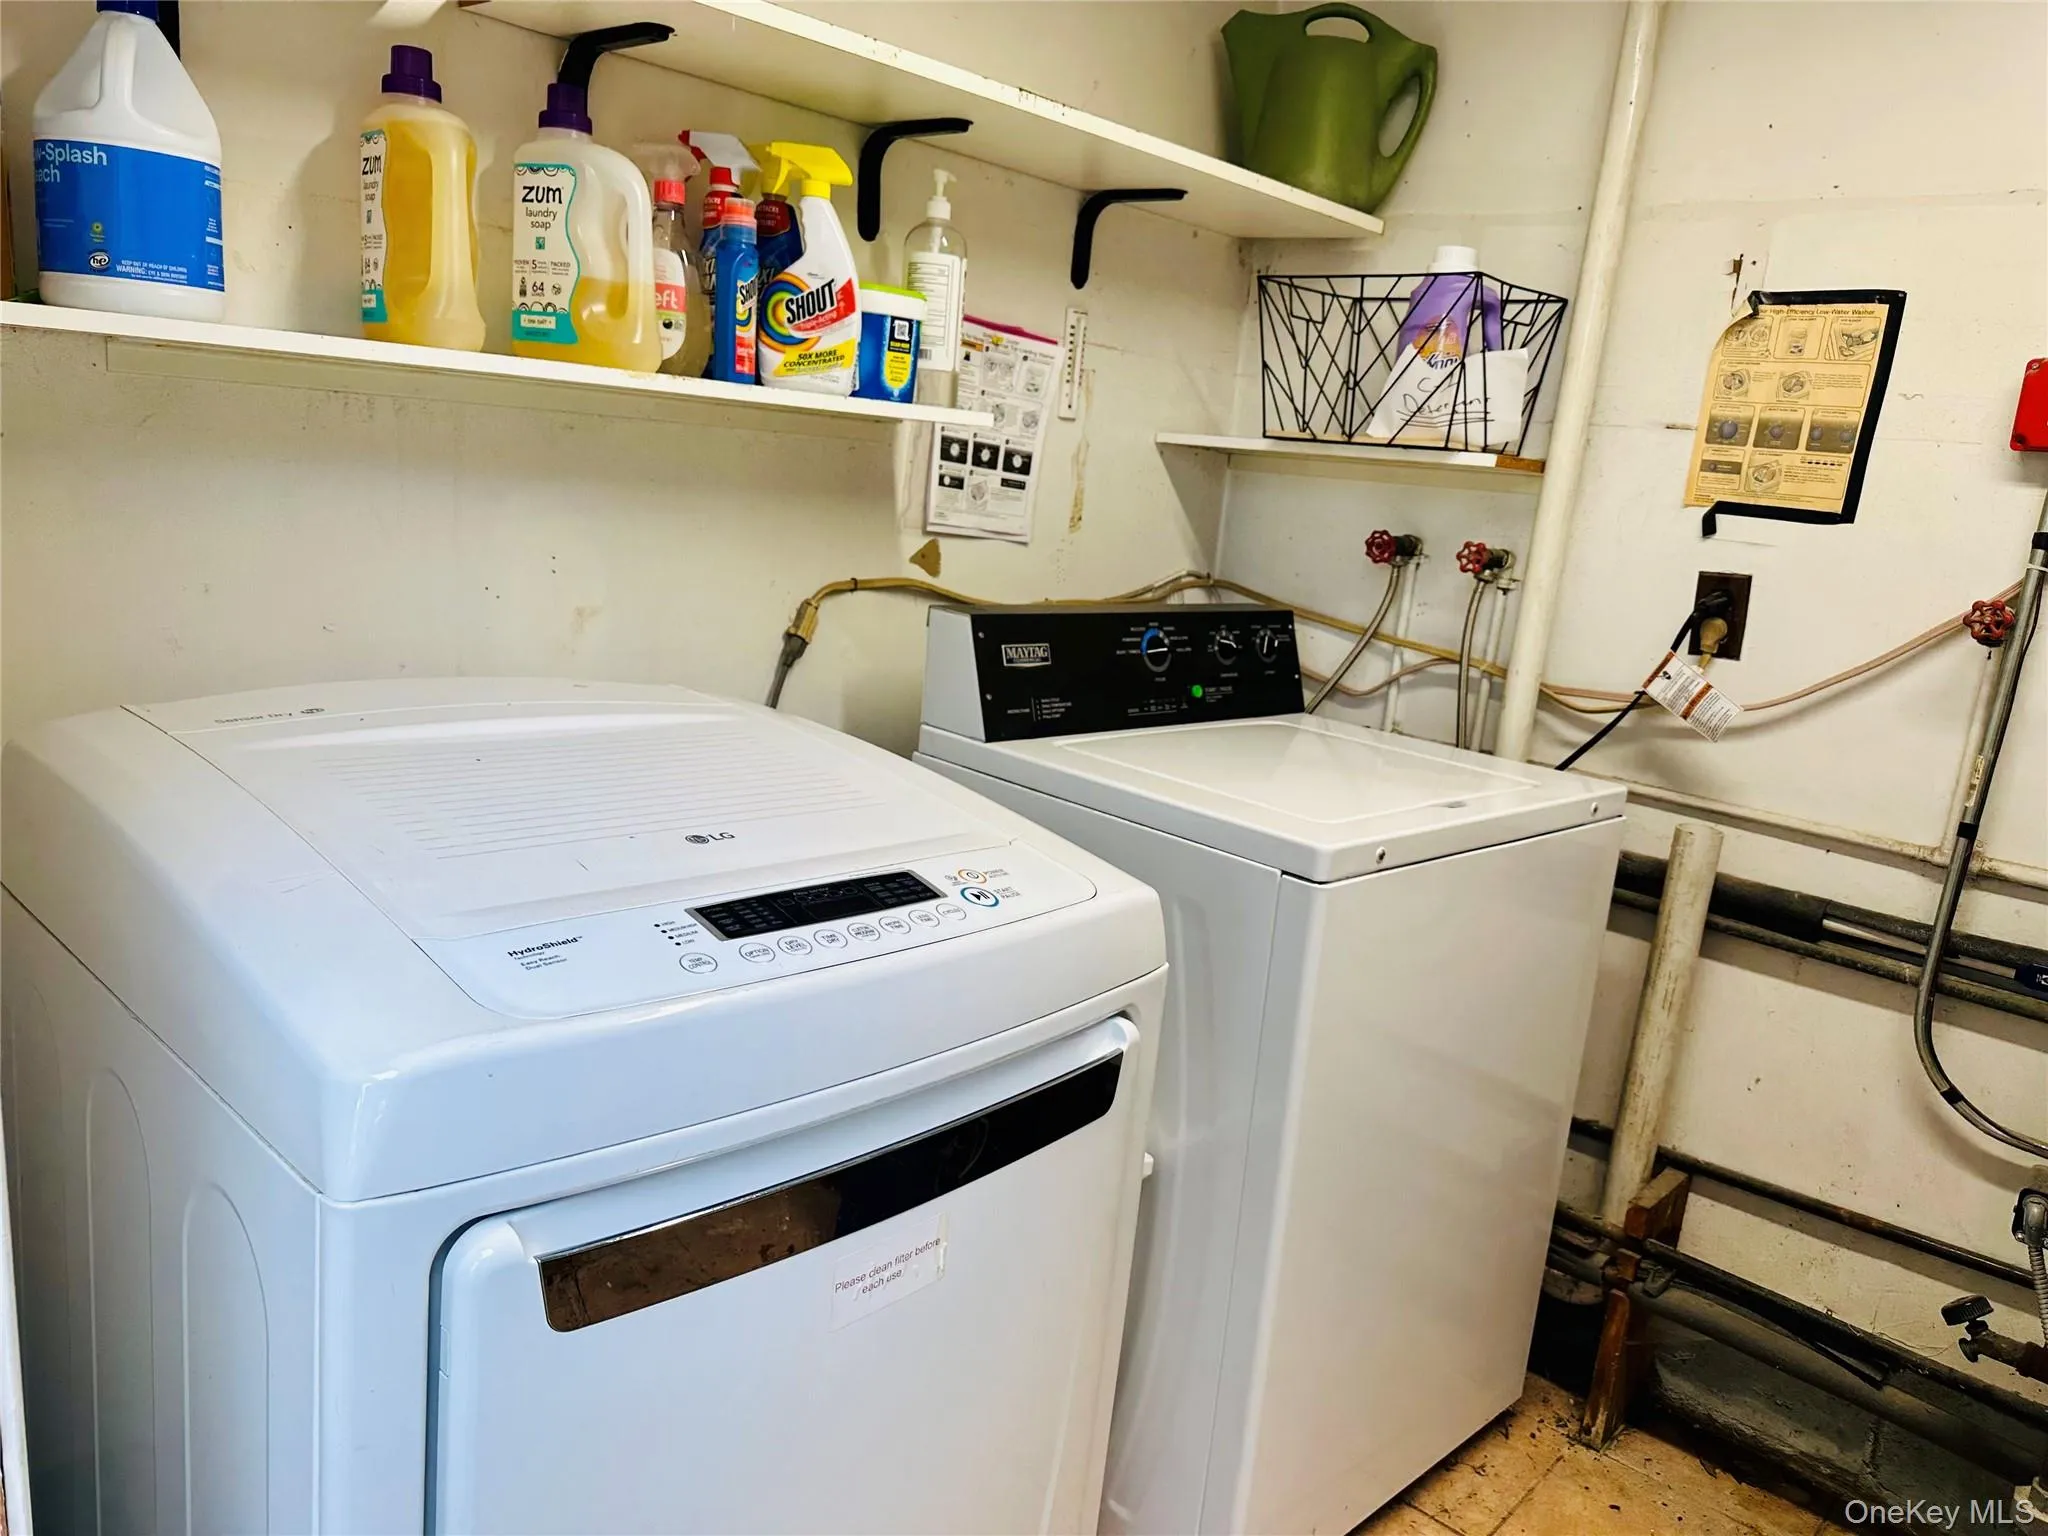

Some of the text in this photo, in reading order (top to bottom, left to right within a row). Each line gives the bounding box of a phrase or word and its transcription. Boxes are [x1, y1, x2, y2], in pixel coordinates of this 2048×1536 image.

[525, 206, 558, 222] laundry
[530, 221, 552, 231] soap
[115, 263, 148, 275] WARNING:
[531, 259, 538, 270] 5
[531, 281, 545, 293] 64
[784, 277, 836, 324] SHOUT
[814, 349, 838, 359] MORE
[783, 354, 846, 369] CONCENTRATED
[1005, 646, 1048, 659] MAYTAG
[707, 831, 736, 842] LG
[744, 947, 770, 957] OPTION
[834, 1237, 941, 1294] Please clean filter before
[861, 1268, 903, 1295] each use
